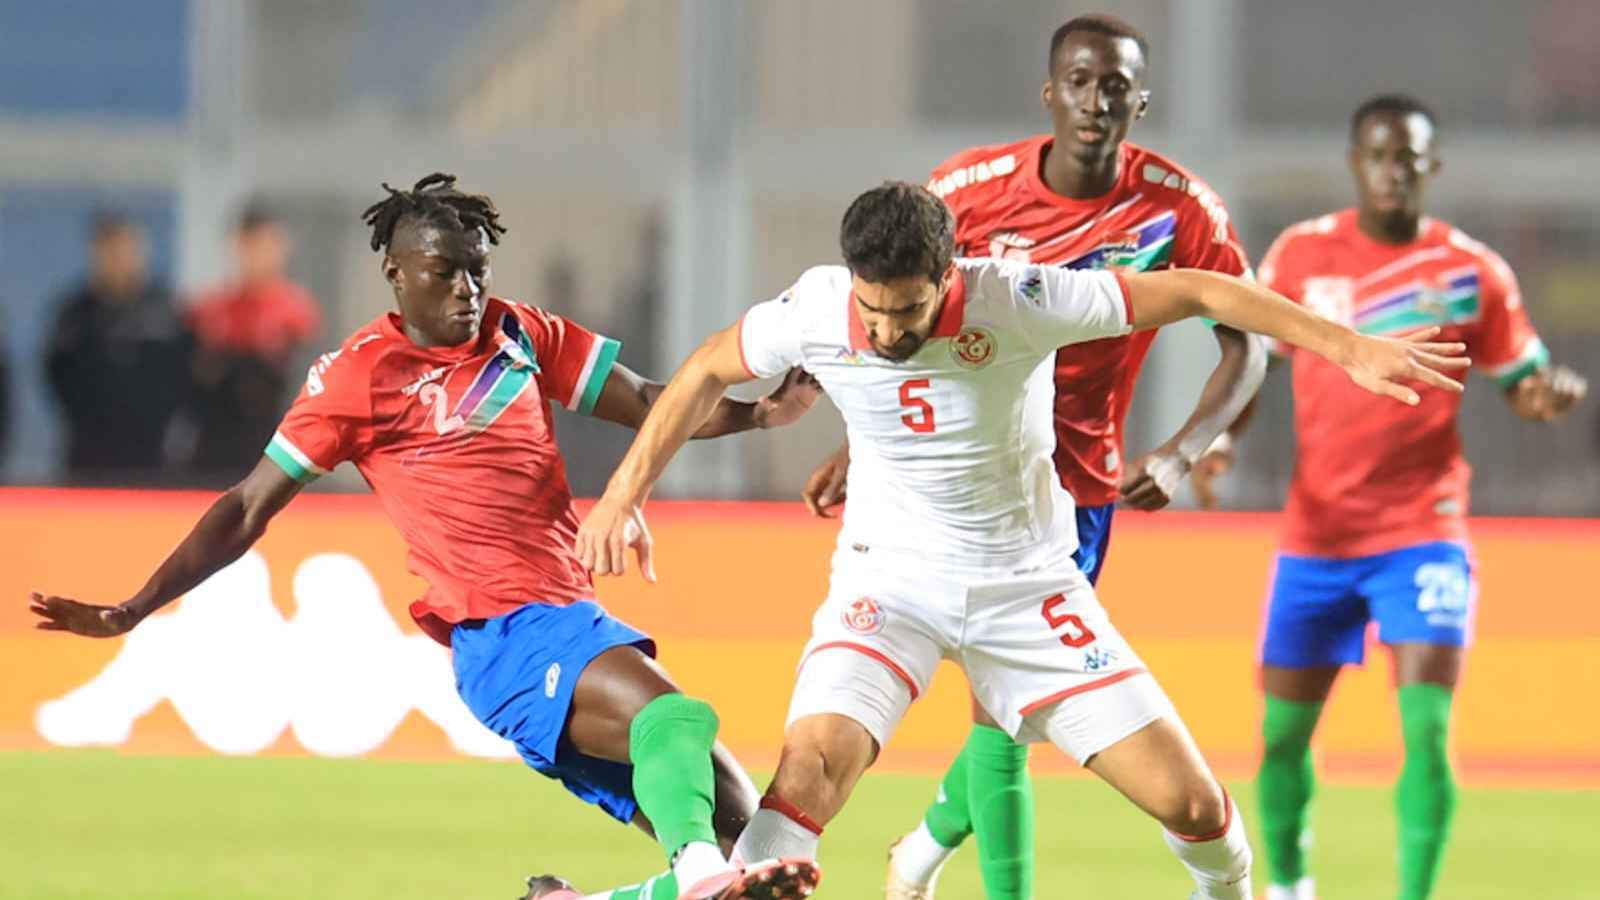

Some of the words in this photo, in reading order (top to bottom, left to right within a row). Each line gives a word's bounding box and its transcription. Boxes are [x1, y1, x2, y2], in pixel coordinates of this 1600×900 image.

[419, 382, 465, 435] 2
[898, 379, 935, 433] 5
[1041, 593, 1096, 648] 5
